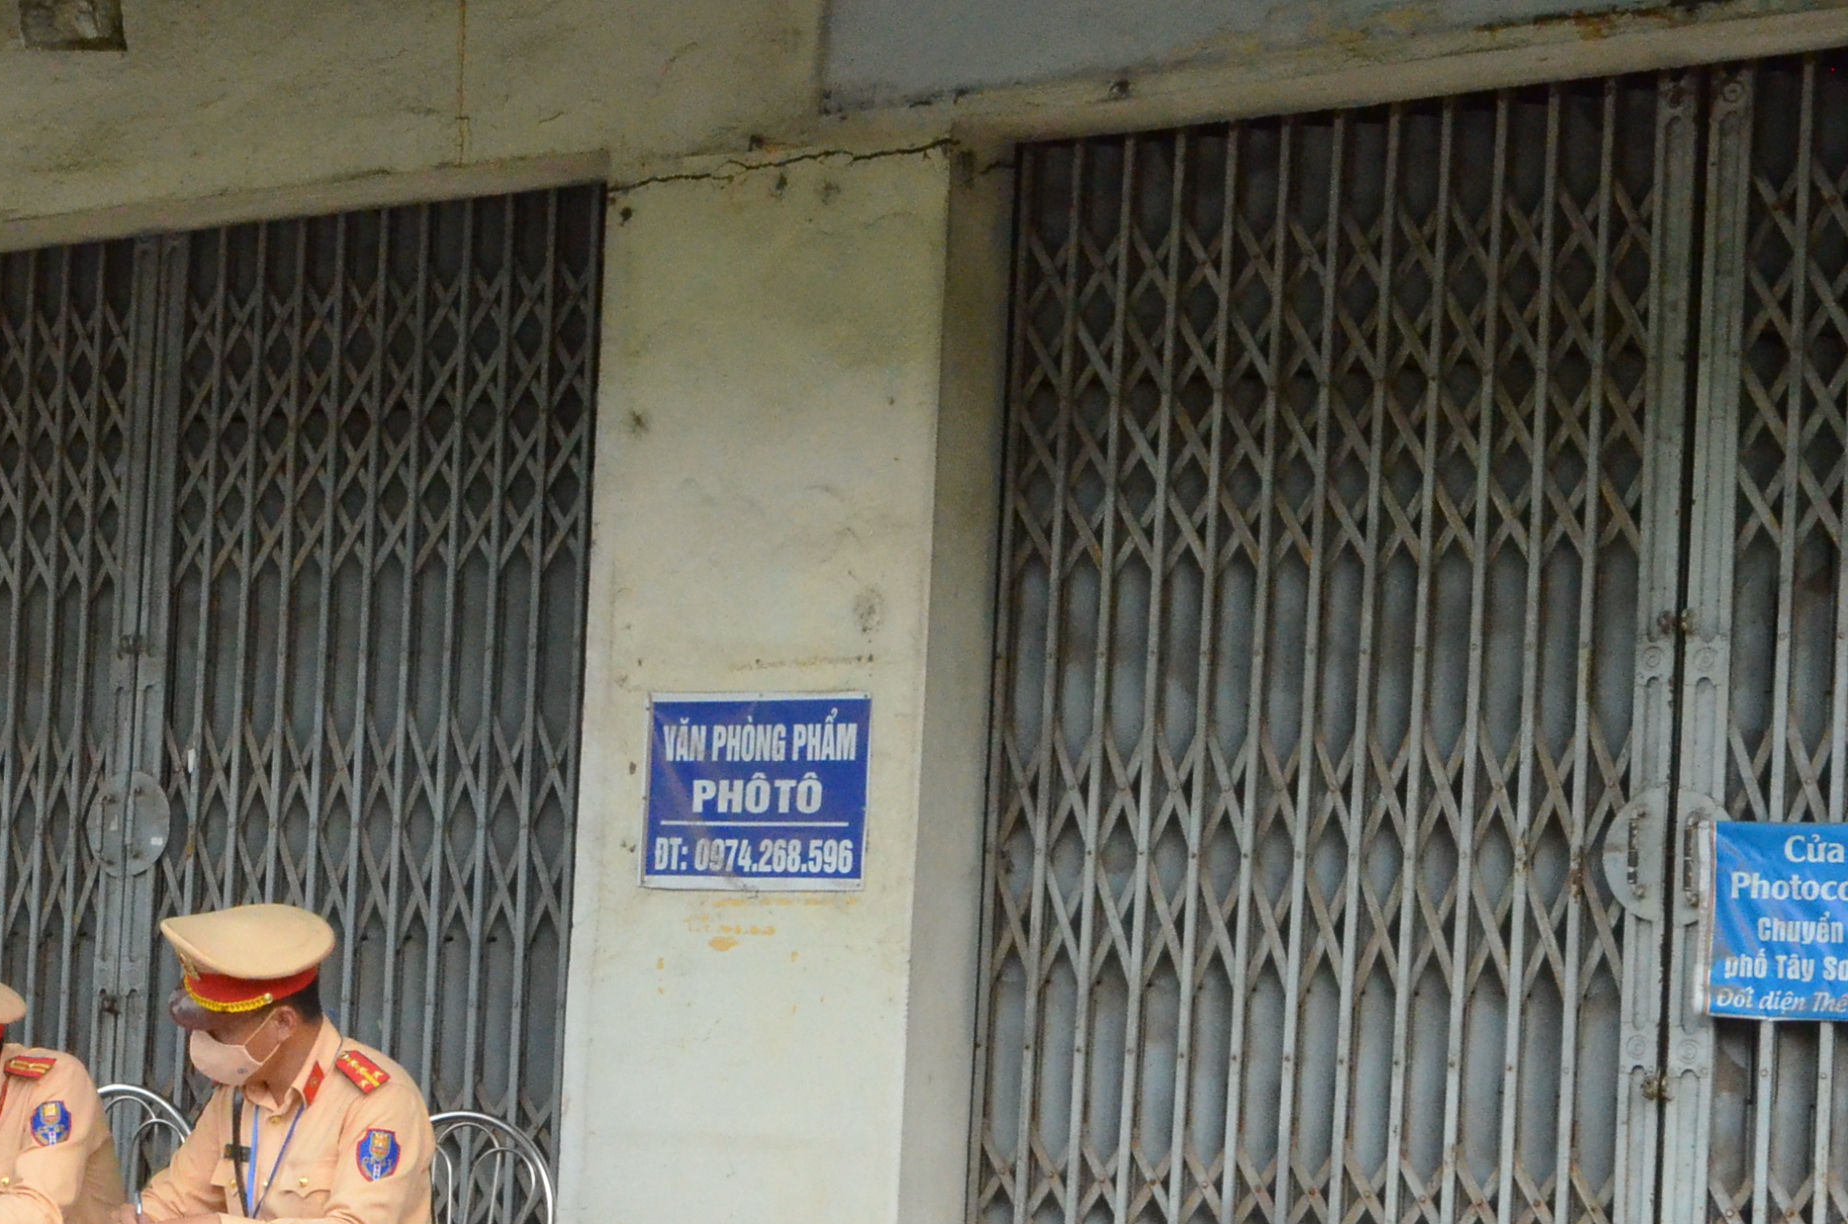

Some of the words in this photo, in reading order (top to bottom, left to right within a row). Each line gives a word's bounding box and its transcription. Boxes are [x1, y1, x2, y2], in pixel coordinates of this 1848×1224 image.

[663, 717, 707, 762] VĂN
[711, 716, 787, 762] PHÒNG
[792, 708, 858, 761] PHẨM
[692, 772, 823, 814] PHÔTÔ
[654, 837, 689, 871] ĐT:
[694, 839, 854, 874] 0974.268.596
[1784, 834, 1845, 863] Cửa
[1757, 911, 1844, 944] Chuyển
[1724, 948, 1768, 979] phố
[1775, 954, 1815, 982] Tây
[1758, 990, 1806, 1014] diện
